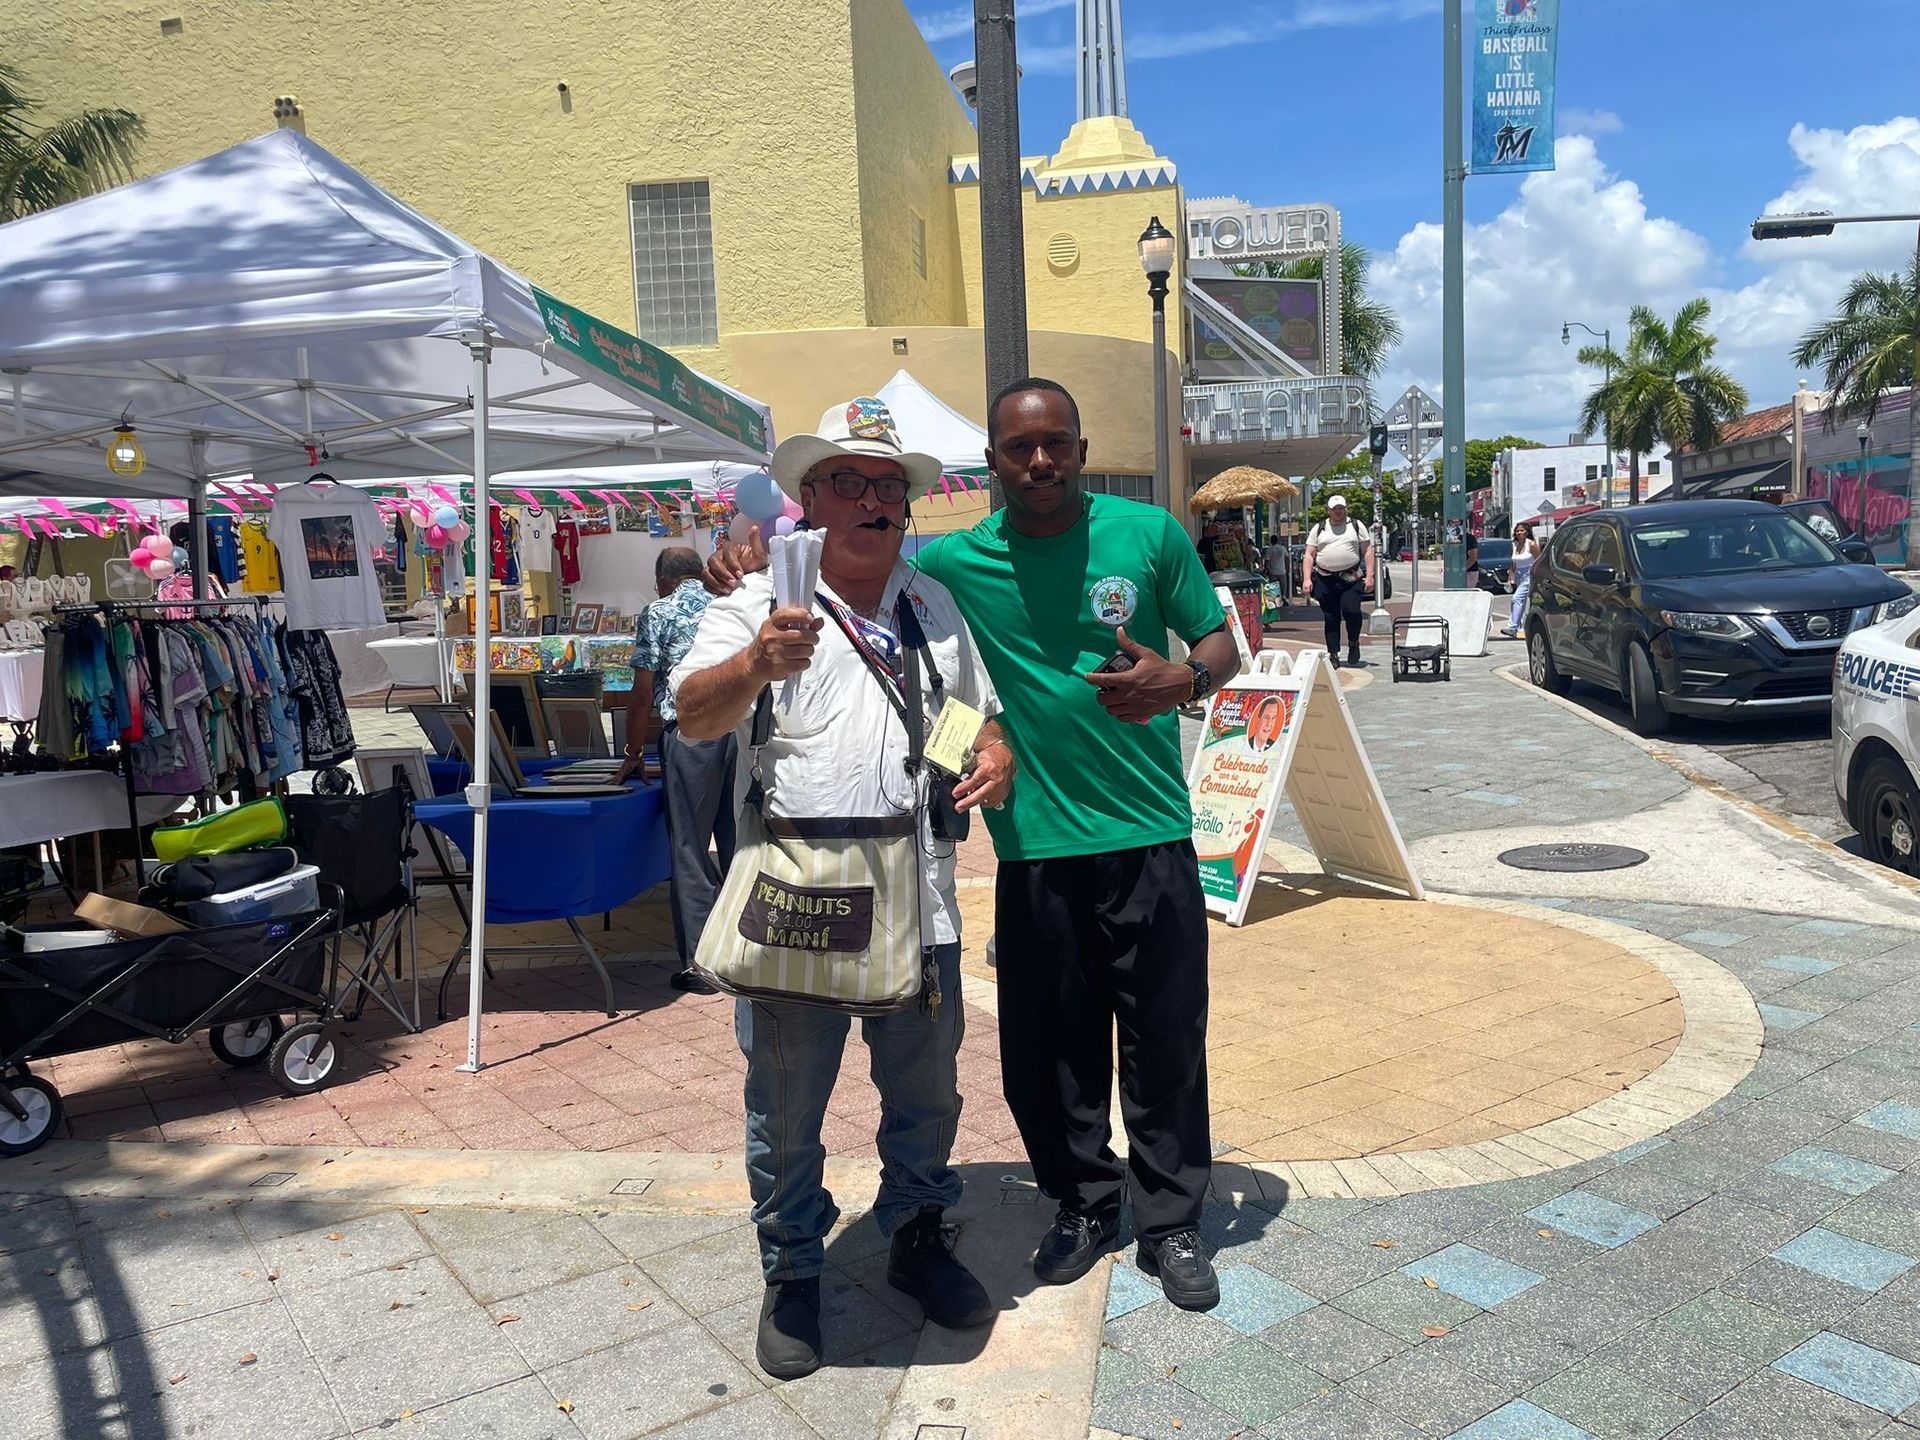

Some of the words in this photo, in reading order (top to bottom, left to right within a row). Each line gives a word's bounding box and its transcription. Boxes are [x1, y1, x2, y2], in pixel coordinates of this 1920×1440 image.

[1483, 25, 1513, 36] Third
[1513, 23, 1553, 37] Fridays
[1482, 36, 1548, 54] BASEBALL
[1509, 55, 1522, 70] IS
[1495, 72, 1535, 89] LITTLE
[1486, 90, 1541, 107] HAVANA
[1190, 209, 1330, 255] TOWER
[1184, 385, 1365, 436] THEATER
[857, 634, 876, 657] CUBA
[1842, 652, 1900, 695] POLICE
[1213, 754, 1268, 775] Celebrando
[1199, 774, 1263, 798] Comunidad
[1200, 806, 1212, 818] Joe
[757, 881, 851, 916] PEANUTS
